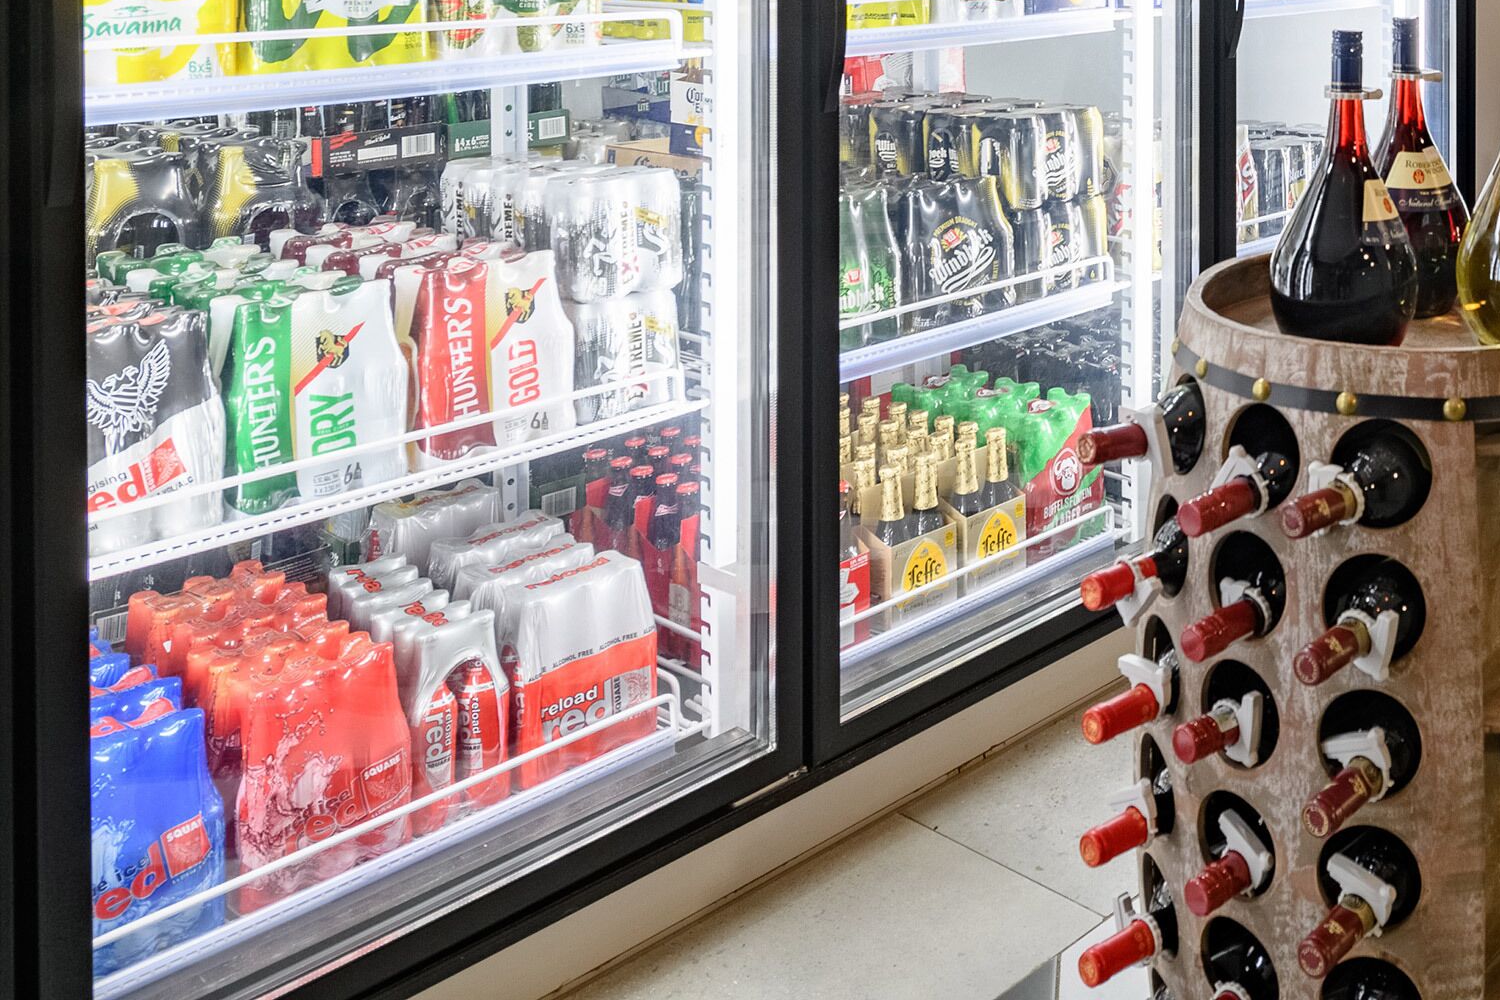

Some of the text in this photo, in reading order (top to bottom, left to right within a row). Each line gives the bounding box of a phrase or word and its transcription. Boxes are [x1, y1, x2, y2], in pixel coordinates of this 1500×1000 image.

[82, 12, 182, 41] Savanna
[637, 104, 651, 112] LITE
[507, 339, 542, 408] GOLD
[309, 392, 358, 458] DRY
[87, 462, 148, 513] ed
[88, 470, 129, 494] gising
[577, 648, 594, 659] FREE
[622, 631, 638, 642] FREE
[471, 698, 481, 734] reload
[541, 685, 598, 719] reload
[541, 677, 613, 745] red
[425, 711, 452, 763] red
[363, 753, 401, 781] SQUARE
[95, 840, 169, 921] ed
